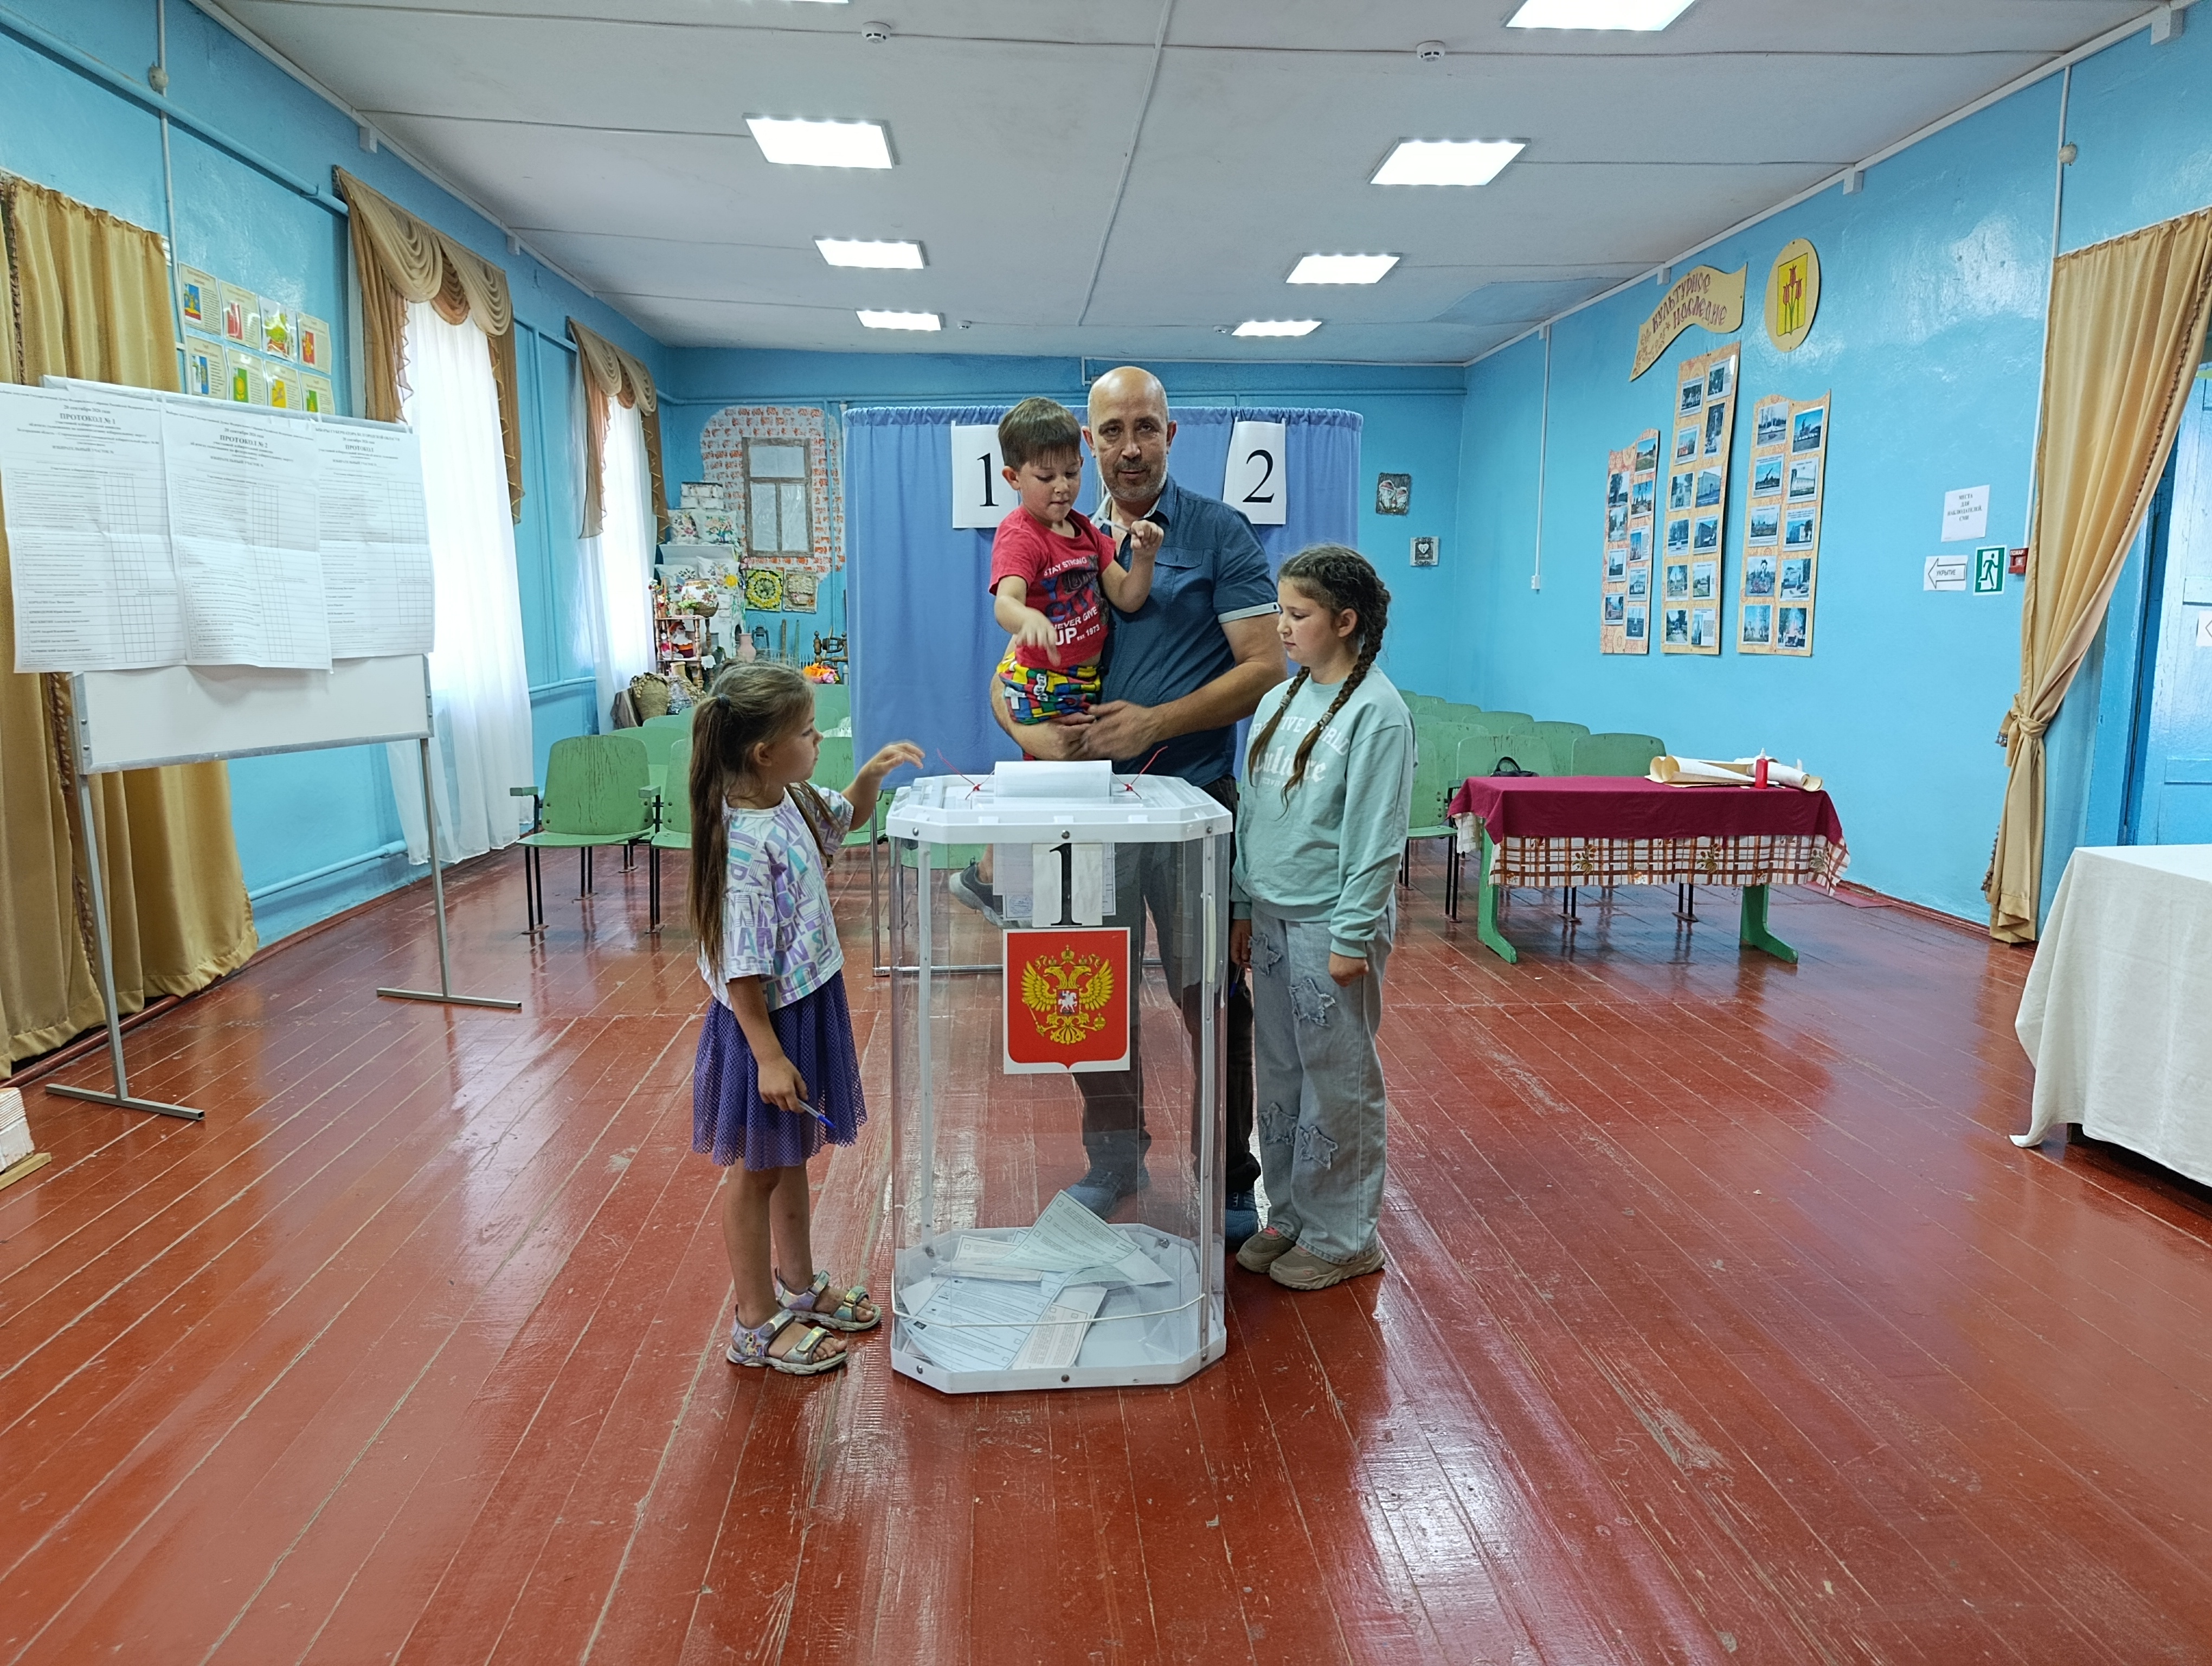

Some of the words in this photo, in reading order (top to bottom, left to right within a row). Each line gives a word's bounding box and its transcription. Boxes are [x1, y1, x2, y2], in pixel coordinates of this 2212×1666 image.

[60, 413, 102, 424] ПРОТОКОЛ
[220, 434, 257, 446] ПРОТОКОЛ
[345, 444, 374, 452] ПРОТОКОЛ
[977, 453, 999, 507] 1
[1243, 450, 1275, 503] 2
[1044, 563, 1061, 576] STAY
[1062, 556, 1087, 568] STRONG
[1083, 606, 1098, 621] GIVE
[1086, 624, 1100, 636] 1973
[1050, 843, 1082, 926] 1
